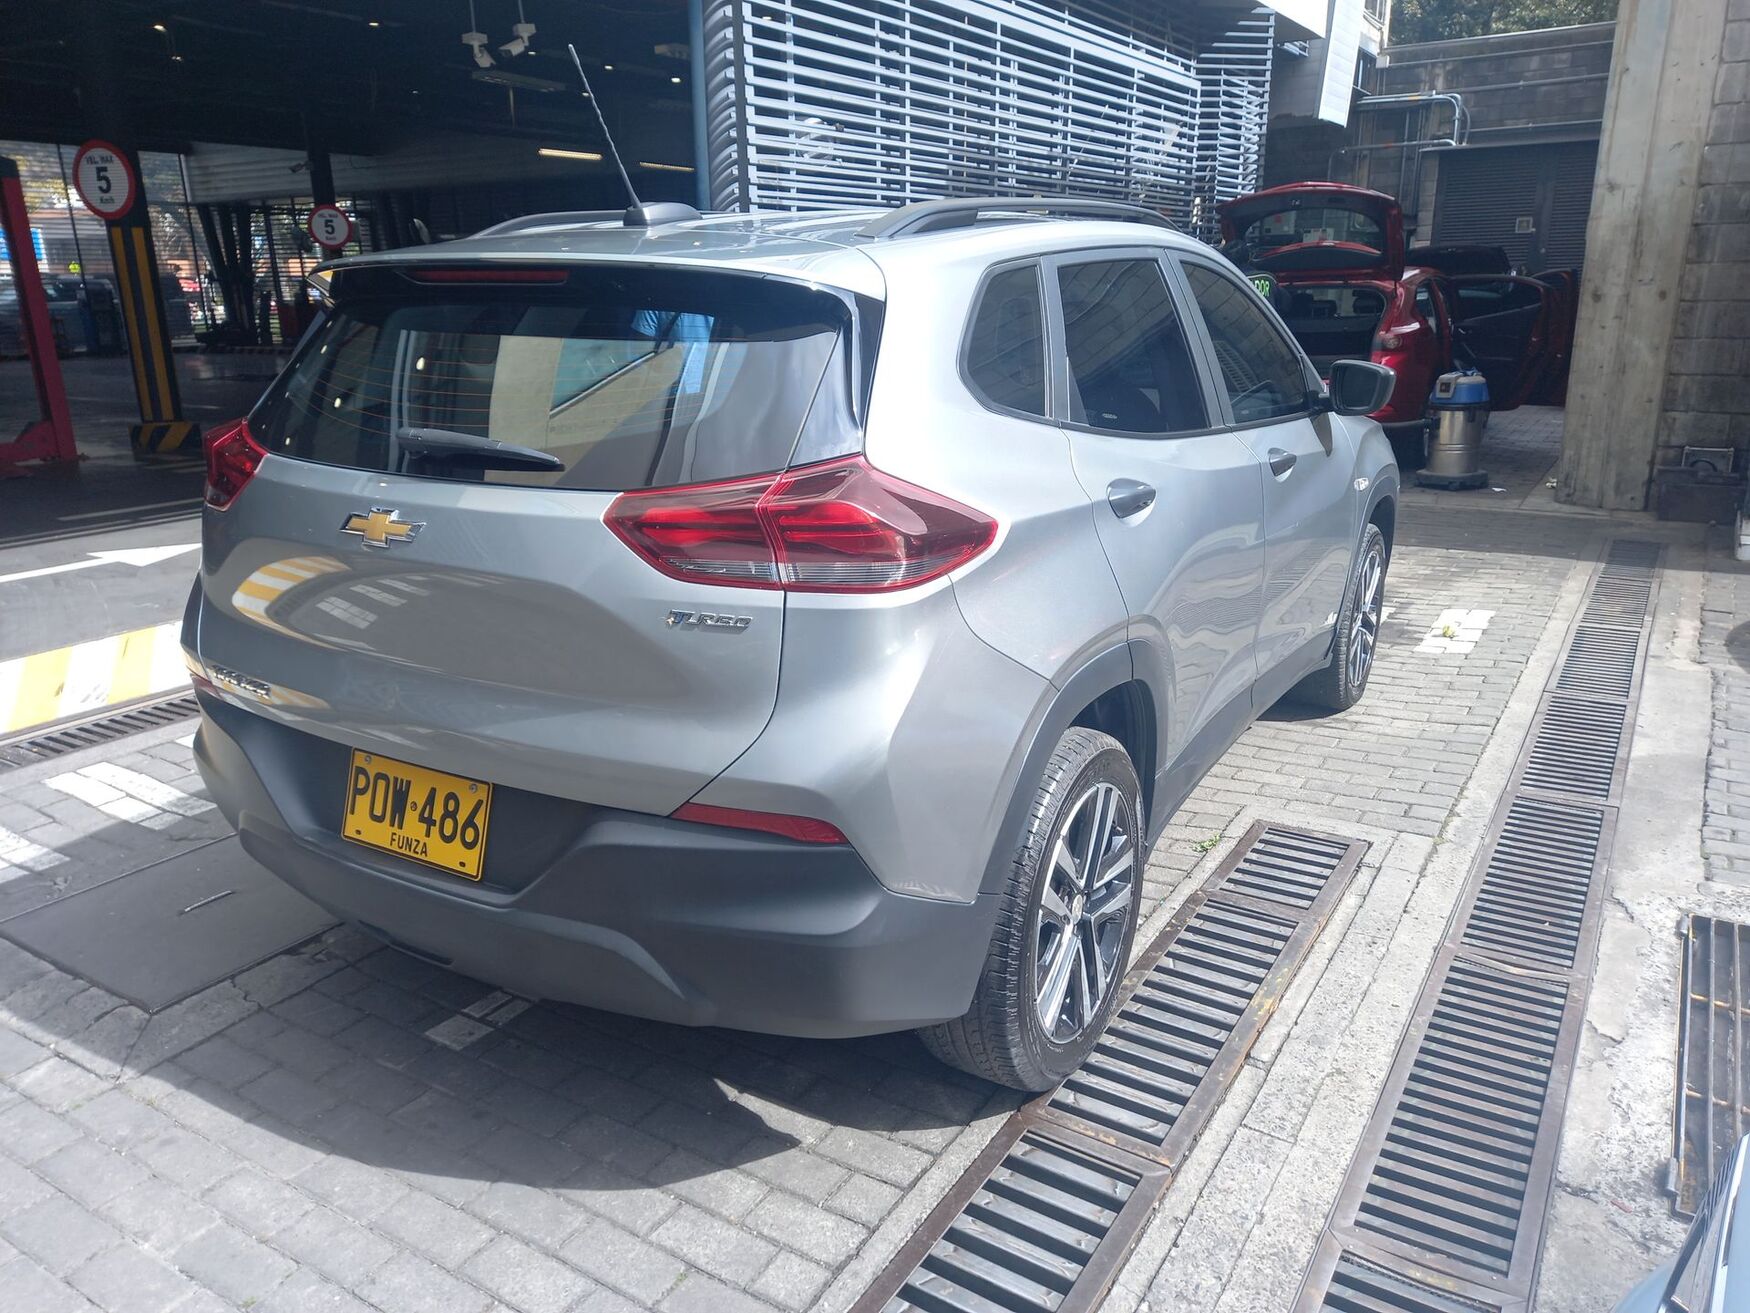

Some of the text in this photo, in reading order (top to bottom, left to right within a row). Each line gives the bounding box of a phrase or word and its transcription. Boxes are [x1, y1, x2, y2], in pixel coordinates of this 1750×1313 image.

[95, 166, 111, 194] 5
[324, 219, 335, 235] 5
[349, 765, 484, 850] POW 486
[389, 832, 428, 857] FUNZA
